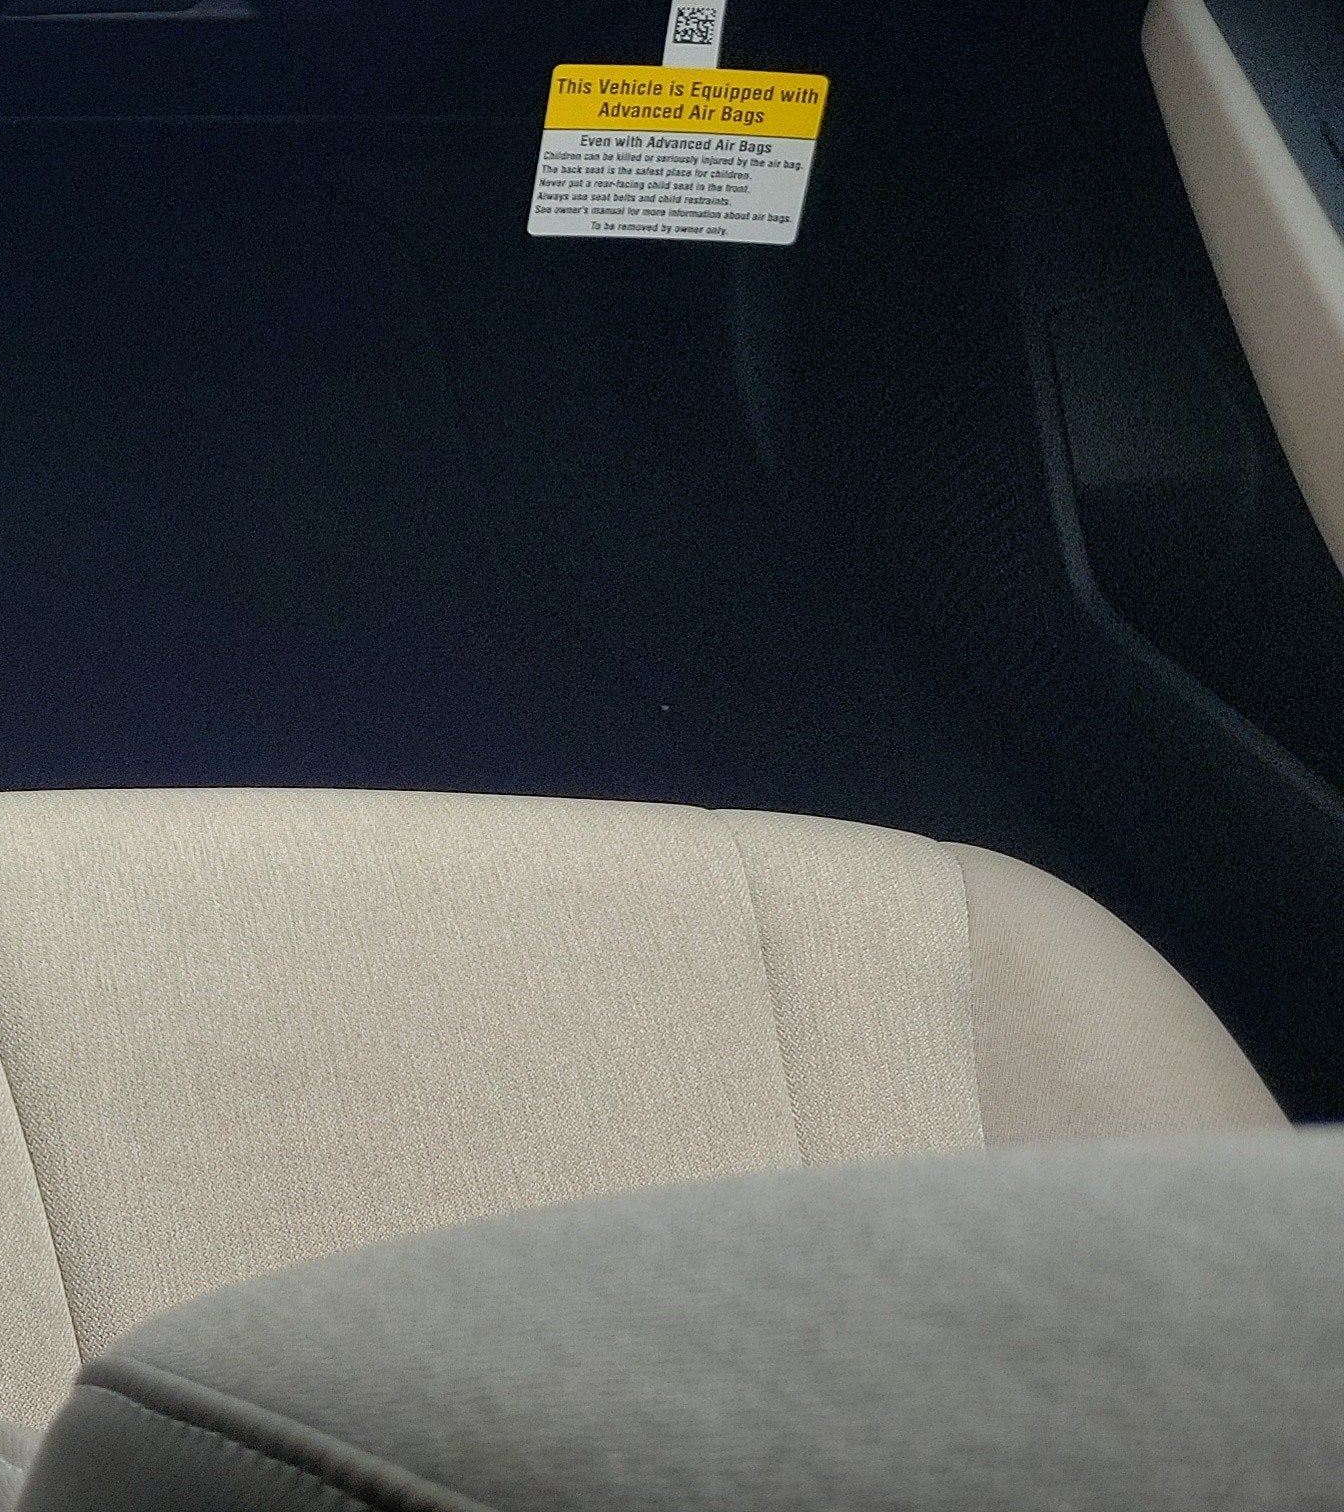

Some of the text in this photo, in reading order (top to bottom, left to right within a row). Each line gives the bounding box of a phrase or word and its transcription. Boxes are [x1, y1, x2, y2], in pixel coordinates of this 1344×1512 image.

[557, 78, 819, 104] This Vehicle is Equipped with
[598, 102, 765, 125] Advanced Air Bags
[580, 135, 772, 155] Even with Advanced Air Bags
[543, 151, 582, 161] Children
[584, 153, 600, 161] can
[617, 152, 642, 162] killed
[655, 155, 698, 165] seriously
[701, 156, 735, 166] injured
[750, 158, 765, 167] the
[767, 159, 781, 168] air
[783, 160, 803, 171] bag.
[542, 164, 558, 174] The
[560, 165, 582, 174] back
[585, 166, 605, 174] seat
[617, 166, 632, 175] the
[635, 167, 664, 176] safest
[665, 168, 692, 178] place
[695, 169, 708, 178] for
[710, 169, 752, 180] children.
[539, 178, 566, 187] Never
[568, 179, 583, 188] put
[593, 180, 645, 190] rear-facing
[647, 181, 671, 189] child
[673, 182, 693, 191] seat
[707, 182, 723, 192] the
[725, 183, 751, 194] front.
[537, 191, 732, 206] Always use seat belts and child restraints.
[534, 204, 792, 224] See owner's manual for more information about air bags.
[617, 223, 658, 232] removed
[674, 225, 704, 234] owner
[705, 225, 728, 236] only.
